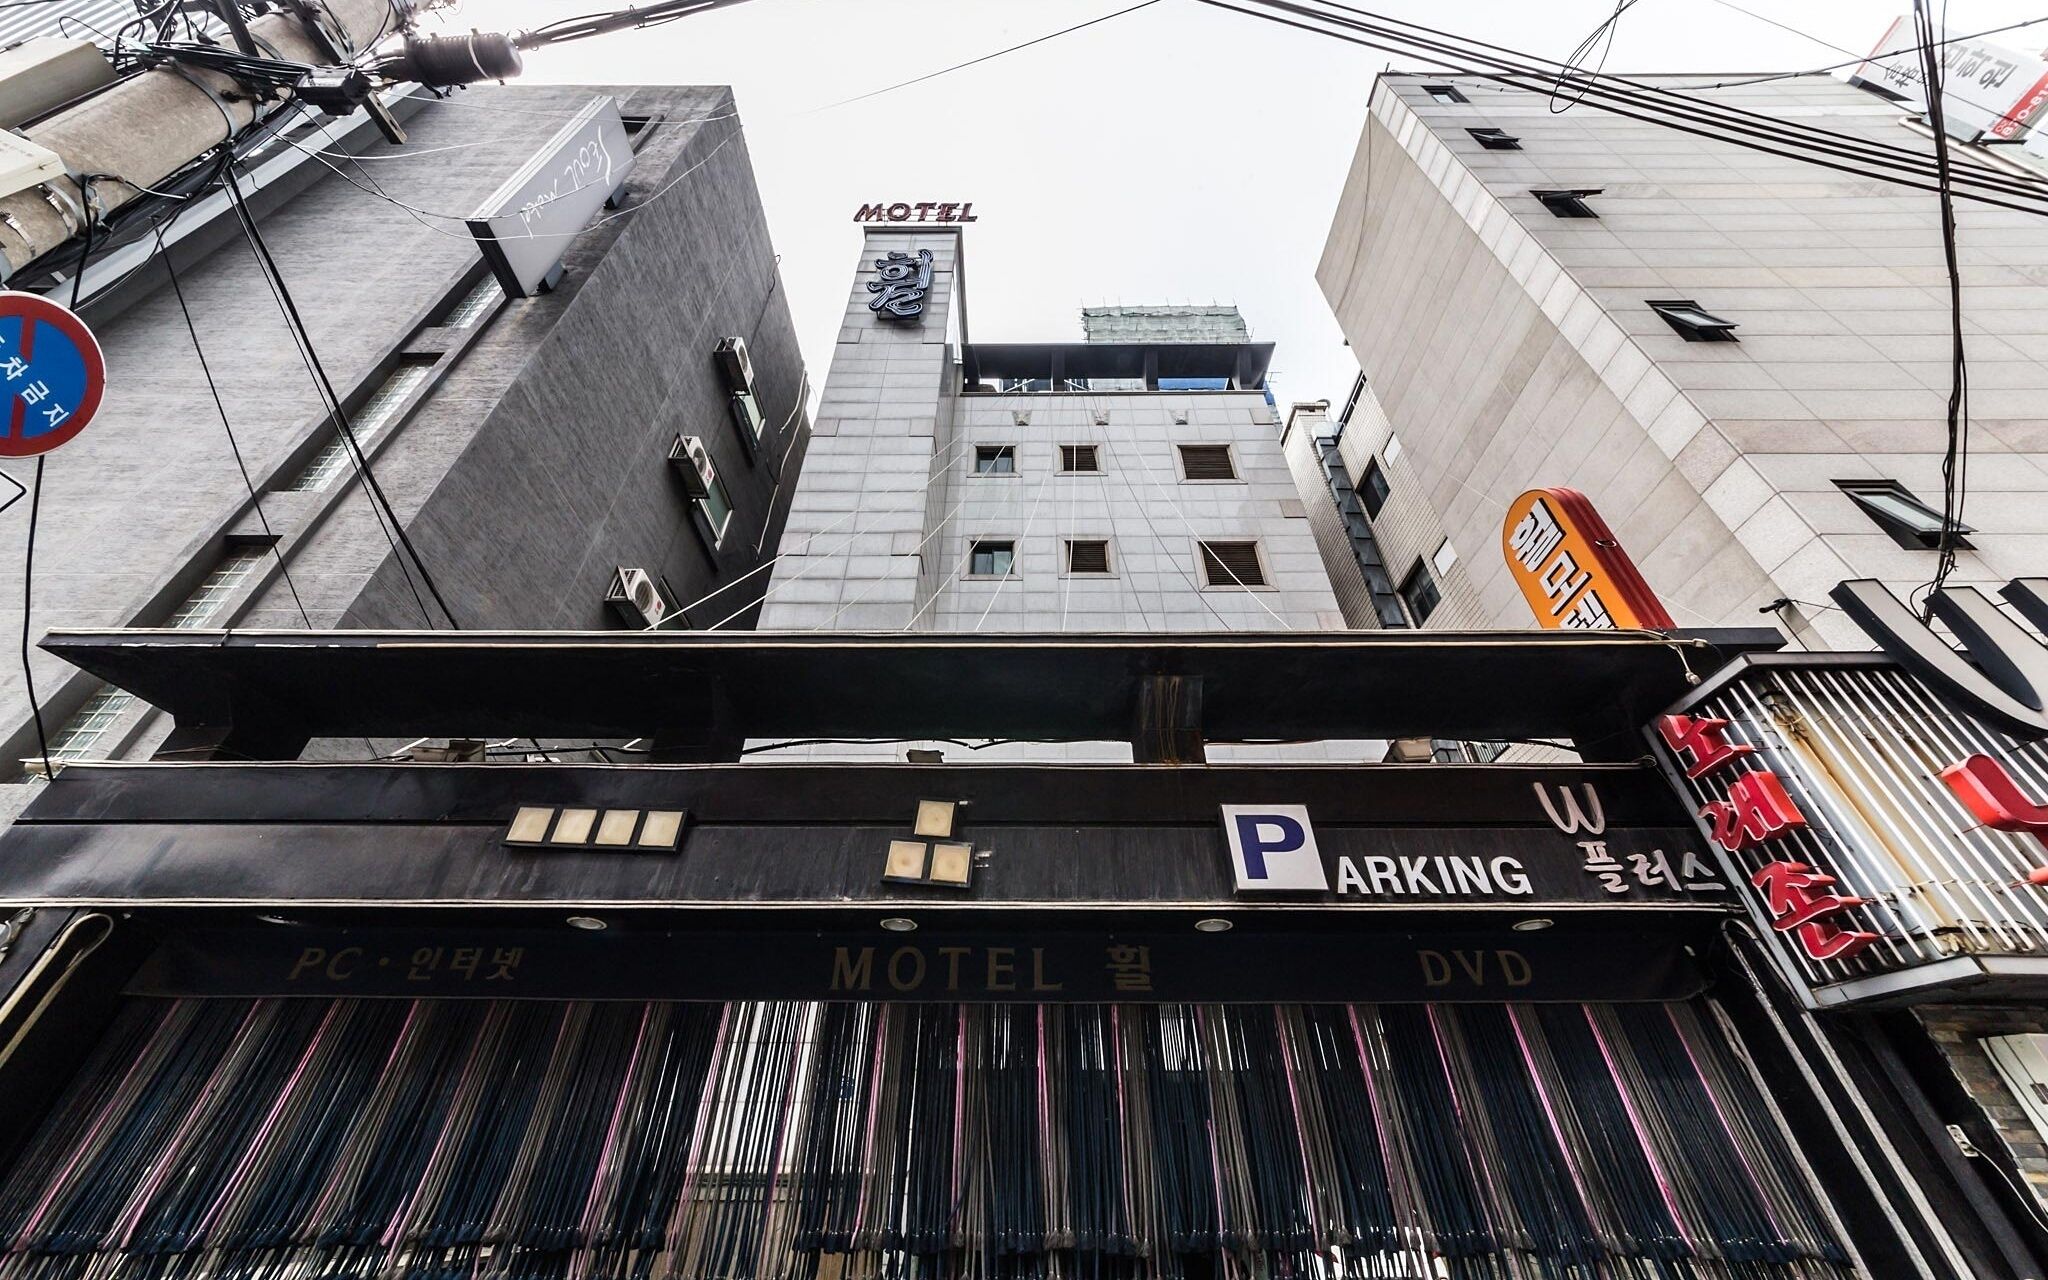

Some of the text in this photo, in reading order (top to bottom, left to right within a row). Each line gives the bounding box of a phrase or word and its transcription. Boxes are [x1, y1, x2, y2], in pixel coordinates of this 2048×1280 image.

[853, 202, 978, 222] MOTEL
[0, 333, 70, 427] 차금지
[1532, 781, 1606, 835] W
[1576, 841, 1727, 893] 플러스
[286, 946, 525, 981] PC 인터넷
[828, 944, 1154, 991] MOTEL 휠
[1417, 950, 1533, 986] DVD
